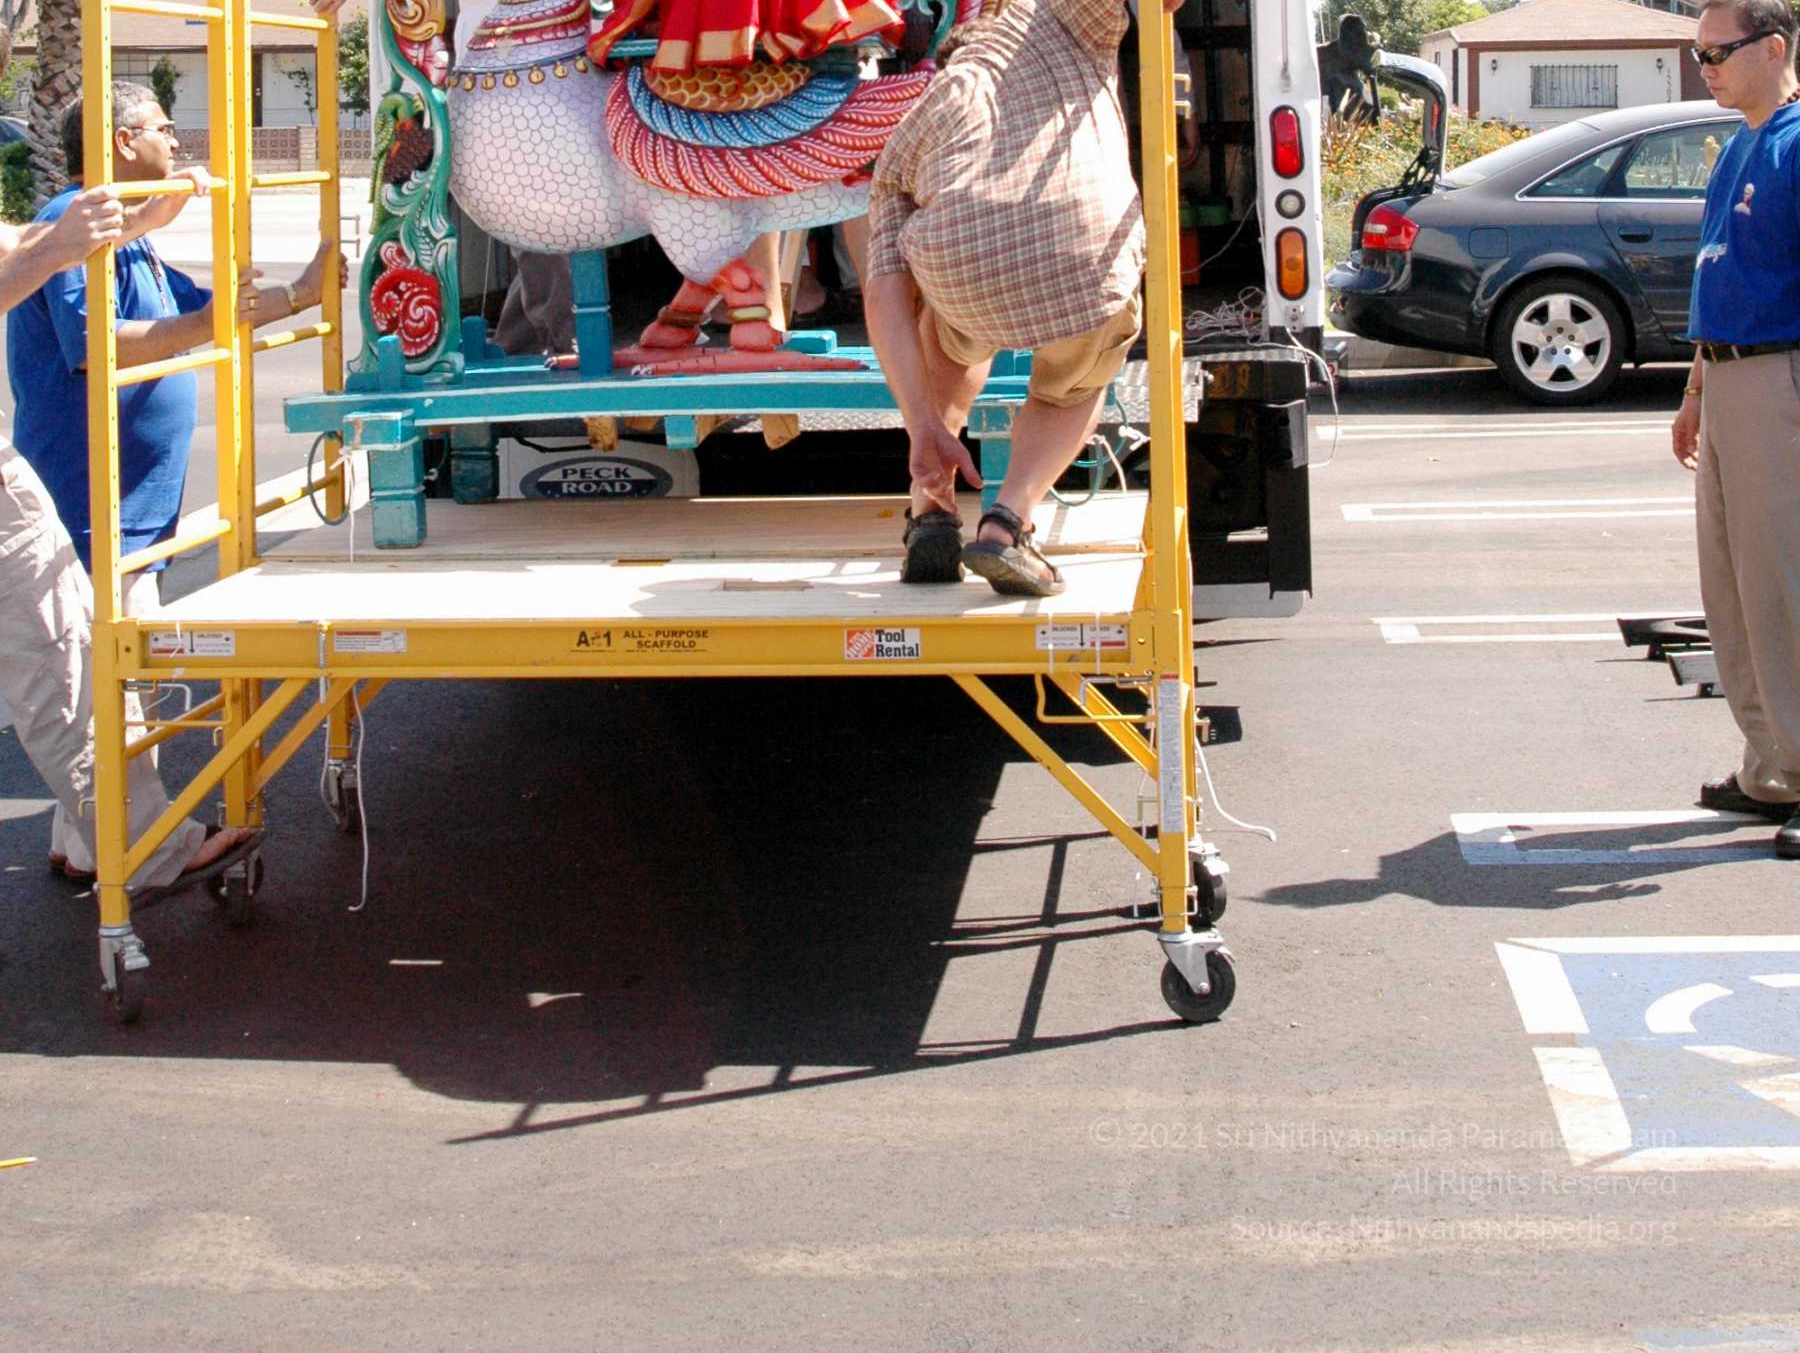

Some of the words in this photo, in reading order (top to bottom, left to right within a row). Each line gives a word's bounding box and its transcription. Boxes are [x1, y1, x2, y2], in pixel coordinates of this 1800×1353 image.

[562, 467, 631, 479] PECK
[562, 482, 632, 493] ROAD
[623, 629, 644, 639] ALL
[655, 629, 709, 639] PURPOSE
[875, 629, 905, 643] Tool
[636, 639, 697, 648] SCAFFOLD
[875, 643, 919, 657] Rental
